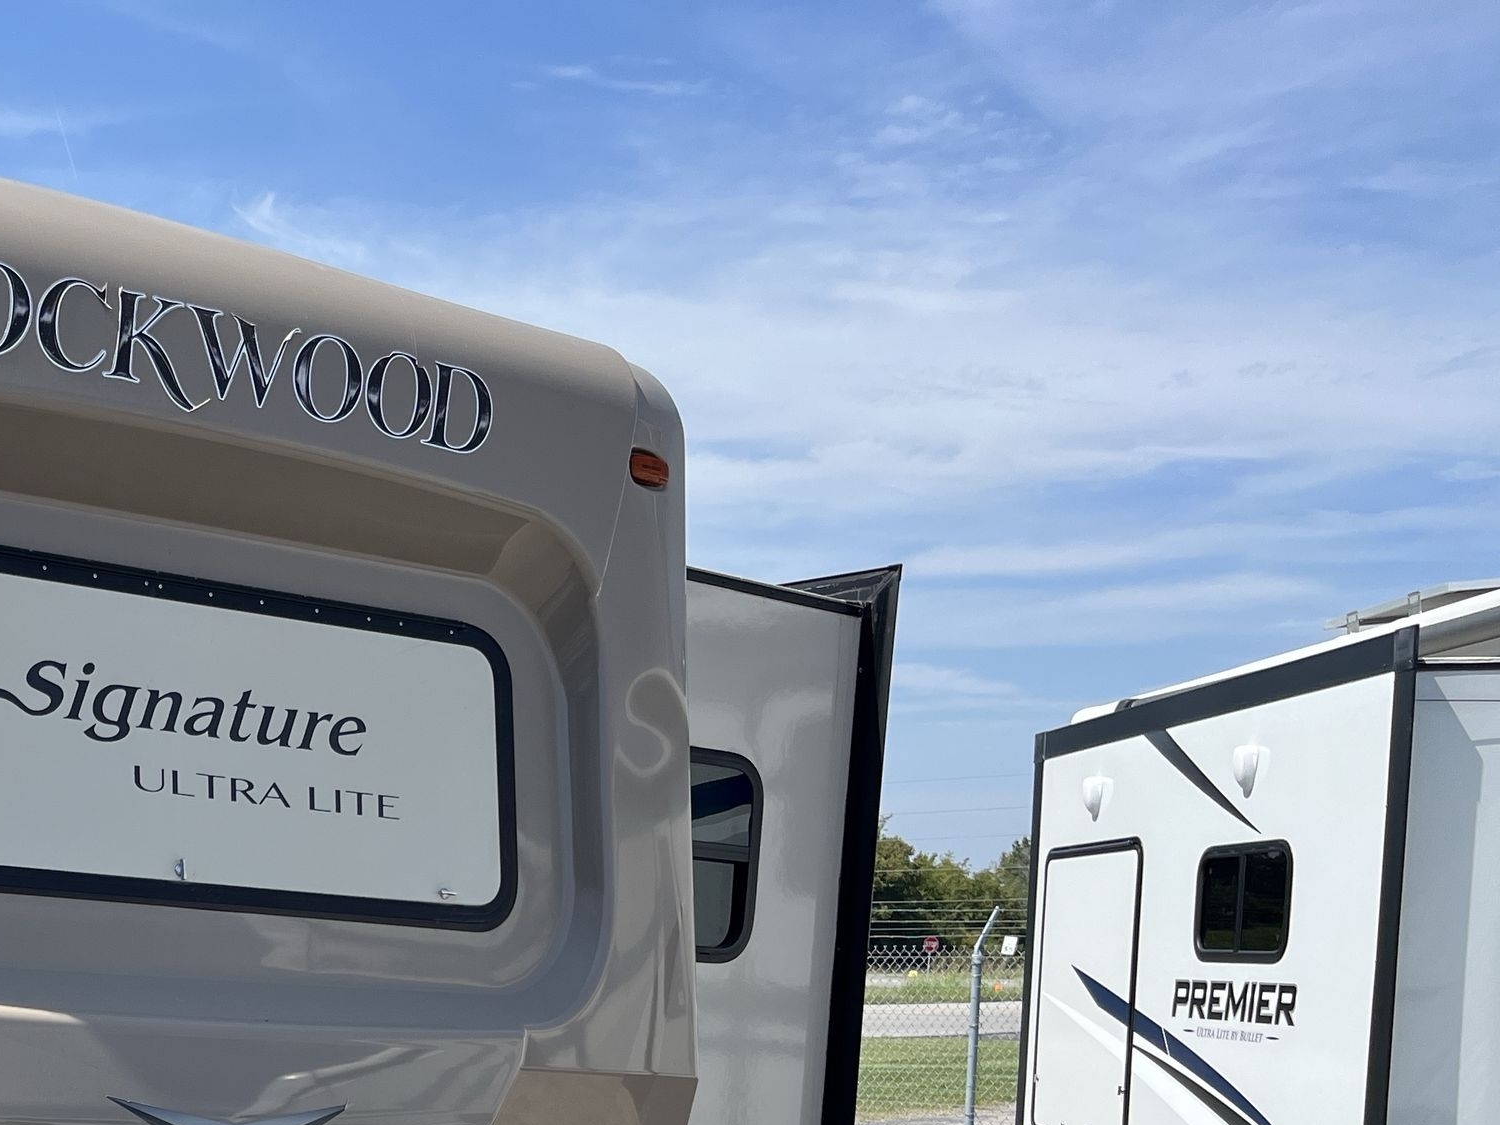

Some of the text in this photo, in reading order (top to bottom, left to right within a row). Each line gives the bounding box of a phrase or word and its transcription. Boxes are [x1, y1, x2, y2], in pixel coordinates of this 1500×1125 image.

[133, 765, 400, 820] ULTRA LITE
[1172, 979, 1297, 1026] PREMIER
